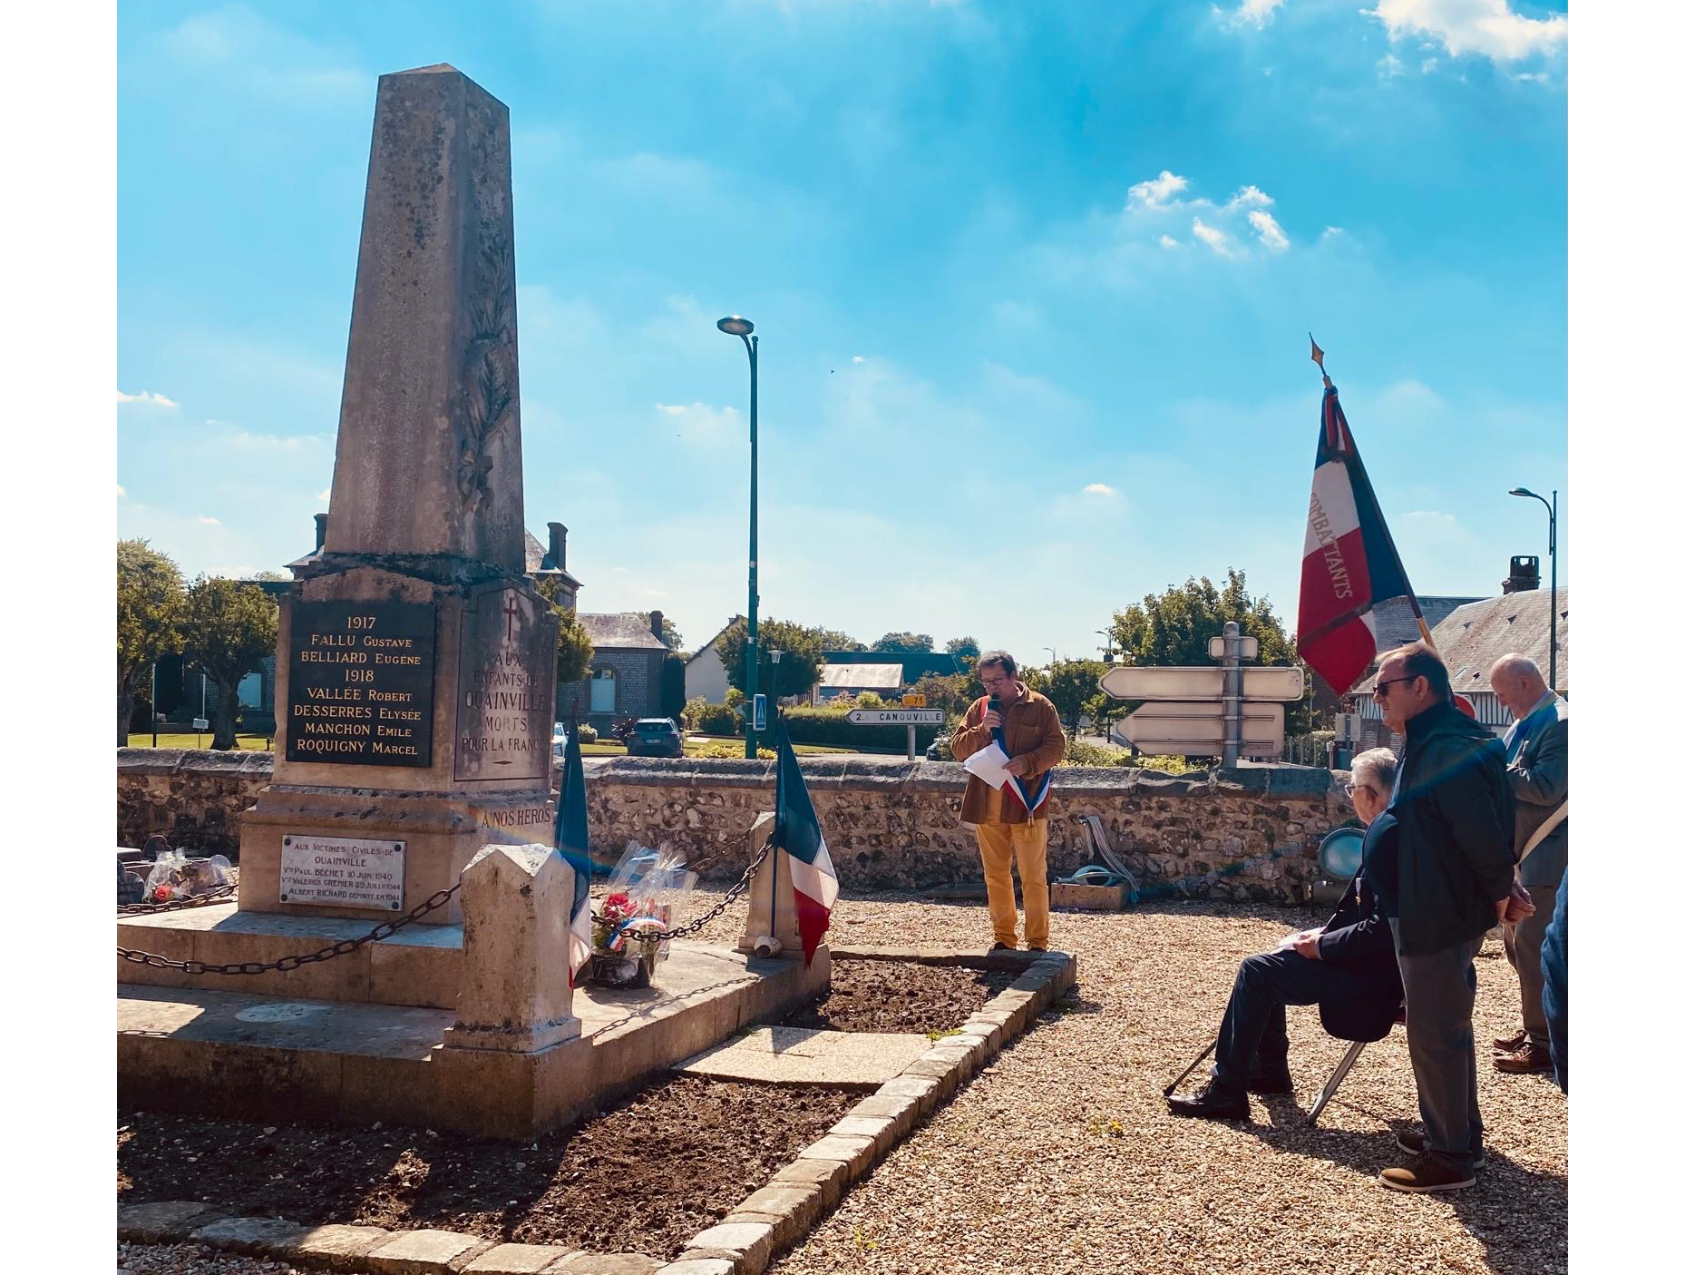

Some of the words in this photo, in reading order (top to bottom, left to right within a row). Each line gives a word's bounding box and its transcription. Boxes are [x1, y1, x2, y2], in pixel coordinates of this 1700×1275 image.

[347, 616, 377, 629] 1917
[311, 634, 356, 646] FALLU
[301, 651, 367, 663] BELLIARD
[495, 651, 522, 667] AUX
[345, 669, 375, 682] 1918
[474, 671, 522, 687] ENFANTS
[307, 686, 362, 700] VALLÉE
[294, 704, 372, 718] DESSERRES
[305, 723, 371, 735] MANCHON
[485, 716, 527, 732] MORTS
[297, 739, 367, 753] ROQUIGNY
[462, 737, 488, 751] POUR
[491, 738, 504, 751] LA
[493, 810, 515, 827] NOS
[517, 808, 551, 825] HEROS
[294, 843, 309, 851] AUX
[313, 844, 346, 853] VICTIMES
[352, 846, 381, 855] CIVILES
[315, 856, 367, 867] OUAINVILLE
[294, 867, 312, 875] PAUL
[375, 873, 393, 881] 1940
[316, 889, 347, 898] RICHARD
